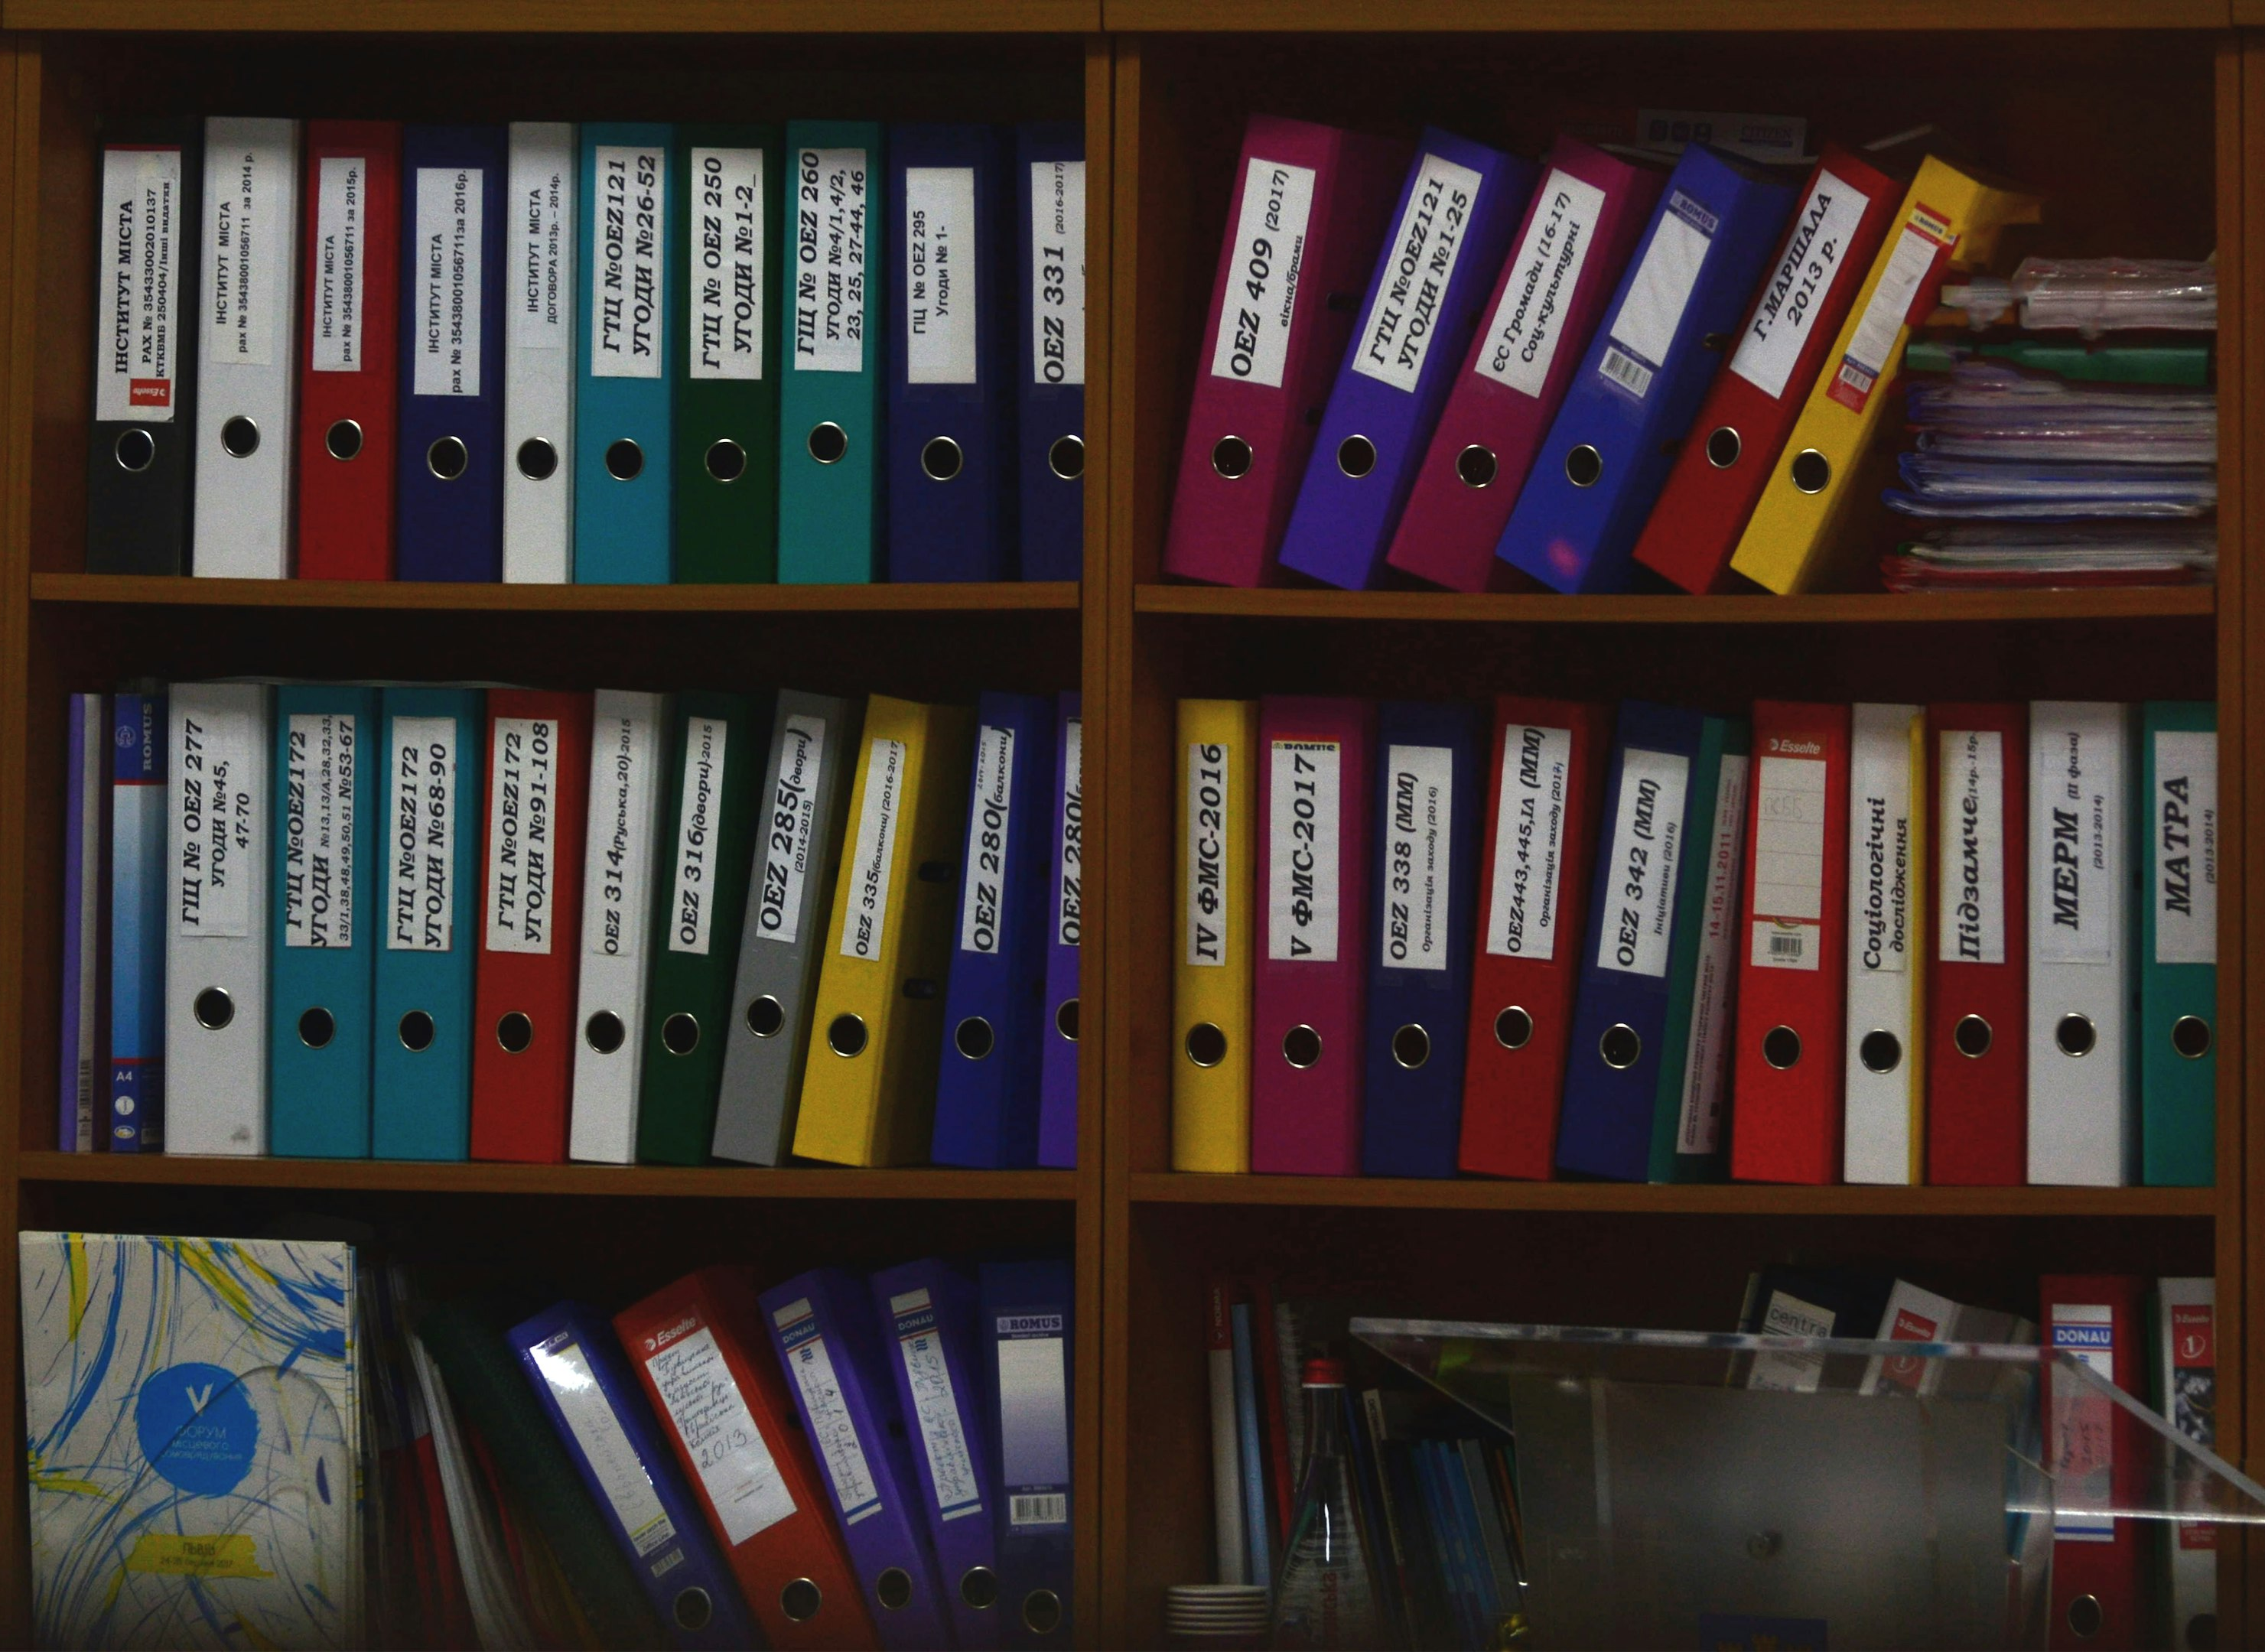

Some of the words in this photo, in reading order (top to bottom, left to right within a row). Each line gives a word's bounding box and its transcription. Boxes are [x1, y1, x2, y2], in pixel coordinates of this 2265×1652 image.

[241, 165, 252, 193] 2014
[242, 196, 252, 210] за
[345, 167, 358, 206] 2015р.
[454, 170, 468, 214] 2016р.
[548, 173, 561, 209] 2014р.
[703, 157, 722, 208] 250
[800, 151, 819, 203] 260
[851, 171, 864, 196] 46
[1054, 162, 1066, 235] (2016-2017)
[1264, 169, 1290, 232] (2017)
[118, 200, 133, 265] МІСТА
[218, 201, 230, 247] МІСТА
[347, 208, 355, 222] за
[529, 188, 541, 235] МІСТА
[604, 160, 626, 291] №OEZ121
[635, 154, 656, 259] №26-52
[828, 169, 847, 267] №4/1,4/2,
[850, 203, 866, 264] 27-44,
[912, 210, 926, 238] 295
[935, 226, 948, 240] 1-
[1678, 199, 1717, 230] ROMUS
[143, 188, 156, 311] 35433002010137
[237, 217, 250, 311] 35438001056711
[324, 235, 334, 275] МІСТА
[430, 233, 442, 279] МІСТА
[548, 220, 560, 256] 2013р.
[703, 214, 721, 269] OEZ
[799, 209, 818, 264] OEZ
[913, 242, 926, 277] OEZ
[935, 245, 948, 264] №
[1389, 177, 1444, 307] №OEZ121
[155, 324, 166, 378] КТКВМБ
[161, 181, 170, 234] видатки
[215, 254, 229, 324] ІНСТИТУТ
[342, 226, 355, 320] 35438001056711
[527, 242, 540, 313] ІНСТИТУТ
[547, 258, 558, 324] ДОГОВОРА
[702, 278, 721, 307] №
[798, 272, 816, 302] №
[848, 272, 864, 301] 25,
[913, 281, 926, 299] №
[936, 268, 950, 317] Угоди
[1043, 246, 1064, 305] 331
[1245, 237, 1273, 301] 409
[1279, 234, 1304, 327] вікна/брами
[1397, 277, 1439, 370] УГОДИ
[1428, 189, 1467, 278] №1-25
[1492, 344, 1510, 372] ЄС
[1502, 259, 1544, 344] Громади
[1537, 191, 1571, 258] (16-17)
[1521, 220, 1580, 363] Соц-культурні
[1752, 193, 1832, 342] Г.МАРШАЛА
[1786, 261, 1823, 327] 2013
[1821, 238, 1837, 265] р.
[115, 270, 131, 374] ІНСТИТУТ
[142, 315, 153, 330] №
[237, 314, 247, 329] №
[322, 277, 334, 338] ІНСТИТУТ
[341, 324, 352, 338] №
[428, 282, 441, 353] ІНСТИТУТ
[633, 263, 656, 356] УГОДИ
[734, 260, 756, 353] УГОДИ
[796, 307, 818, 356] ГІЦ
[826, 270, 843, 340] УГОДИ
[848, 310, 864, 340] 23,
[913, 308, 928, 334] ГІЦ
[142, 334, 152, 364] РАХ
[238, 331, 249, 353] рах
[343, 340, 353, 363] рах
[450, 348, 461, 365] №
[701, 312, 724, 369] ГТЦ
[1043, 316, 1065, 383] OEZ
[1230, 307, 1261, 377] OEZ
[451, 369, 464, 393] рах
[142, 703, 152, 771] ROMUS
[184, 717, 203, 772] 277
[338, 720, 353, 801] №53-67
[1780, 739, 1821, 755] Esselte
[183, 778, 202, 833] OEZ
[212, 760, 229, 814] №45,
[287, 730, 306, 863] №OEZ172
[427, 743, 446, 849] №68-90
[500, 732, 522, 867] №OEZ172
[528, 721, 549, 844] №91-108
[1427, 786, 1439, 826] (2016)
[1551, 761, 1564, 802] (2017)
[235, 792, 250, 849] 47-70
[399, 746, 418, 881] №OEZ172
[794, 799, 813, 873] (2014-2015)
[1196, 743, 1222, 915] ФМС-2016
[1291, 753, 1316, 927] ФМС-2017
[1548, 803, 1561, 847] заходу
[2093, 794, 2104, 870] (2013-2014)
[182, 841, 200, 872] №
[210, 817, 228, 888] УГОДИ
[339, 804, 353, 941] 33/1,38,48,49,50,51
[1425, 828, 1437, 871] заходу
[2052, 807, 2078, 931] МЕРМ
[2162, 776, 2191, 917] МАТРА
[2202, 808, 2216, 885] (2013-2014)
[181, 876, 203, 926] ГІЦ
[311, 854, 330, 947] УГОДИ
[424, 854, 446, 948] УГОДИ
[524, 848, 546, 943] УГОДИ
[760, 860, 789, 931] OEZ
[1539, 850, 1556, 928] Організація
[1653, 863, 1671, 936] Ініціативи
[1662, 821, 1678, 862] (2016)
[1709, 831, 1731, 938] 14-15.11.2011
[1863, 797, 1886, 970] Соціологічні
[1888, 818, 1907, 953] дослідження
[604, 908, 620, 956] OEZ
[679, 889, 699, 945] OEZ
[855, 915, 873, 956] OEZ
[974, 882, 997, 951] OEZ
[1196, 922, 1218, 961] IV
[1389, 901, 1409, 961] OEZ
[1421, 875, 1434, 953] Організація
[1616, 907, 1640, 967] OEZ
[1290, 934, 1312, 957] V
[116, 1071, 133, 1081] A4
[657, 1316, 697, 1346] Esselte
[781, 1322, 816, 1345] DONAU
[897, 1314, 934, 1332] DONAU
[1009, 1317, 1060, 1329] ROMUS
[2055, 1328, 2111, 1344] DONAU
[185, 1381, 214, 1417] V
[701, 1428, 748, 1469] 2013
